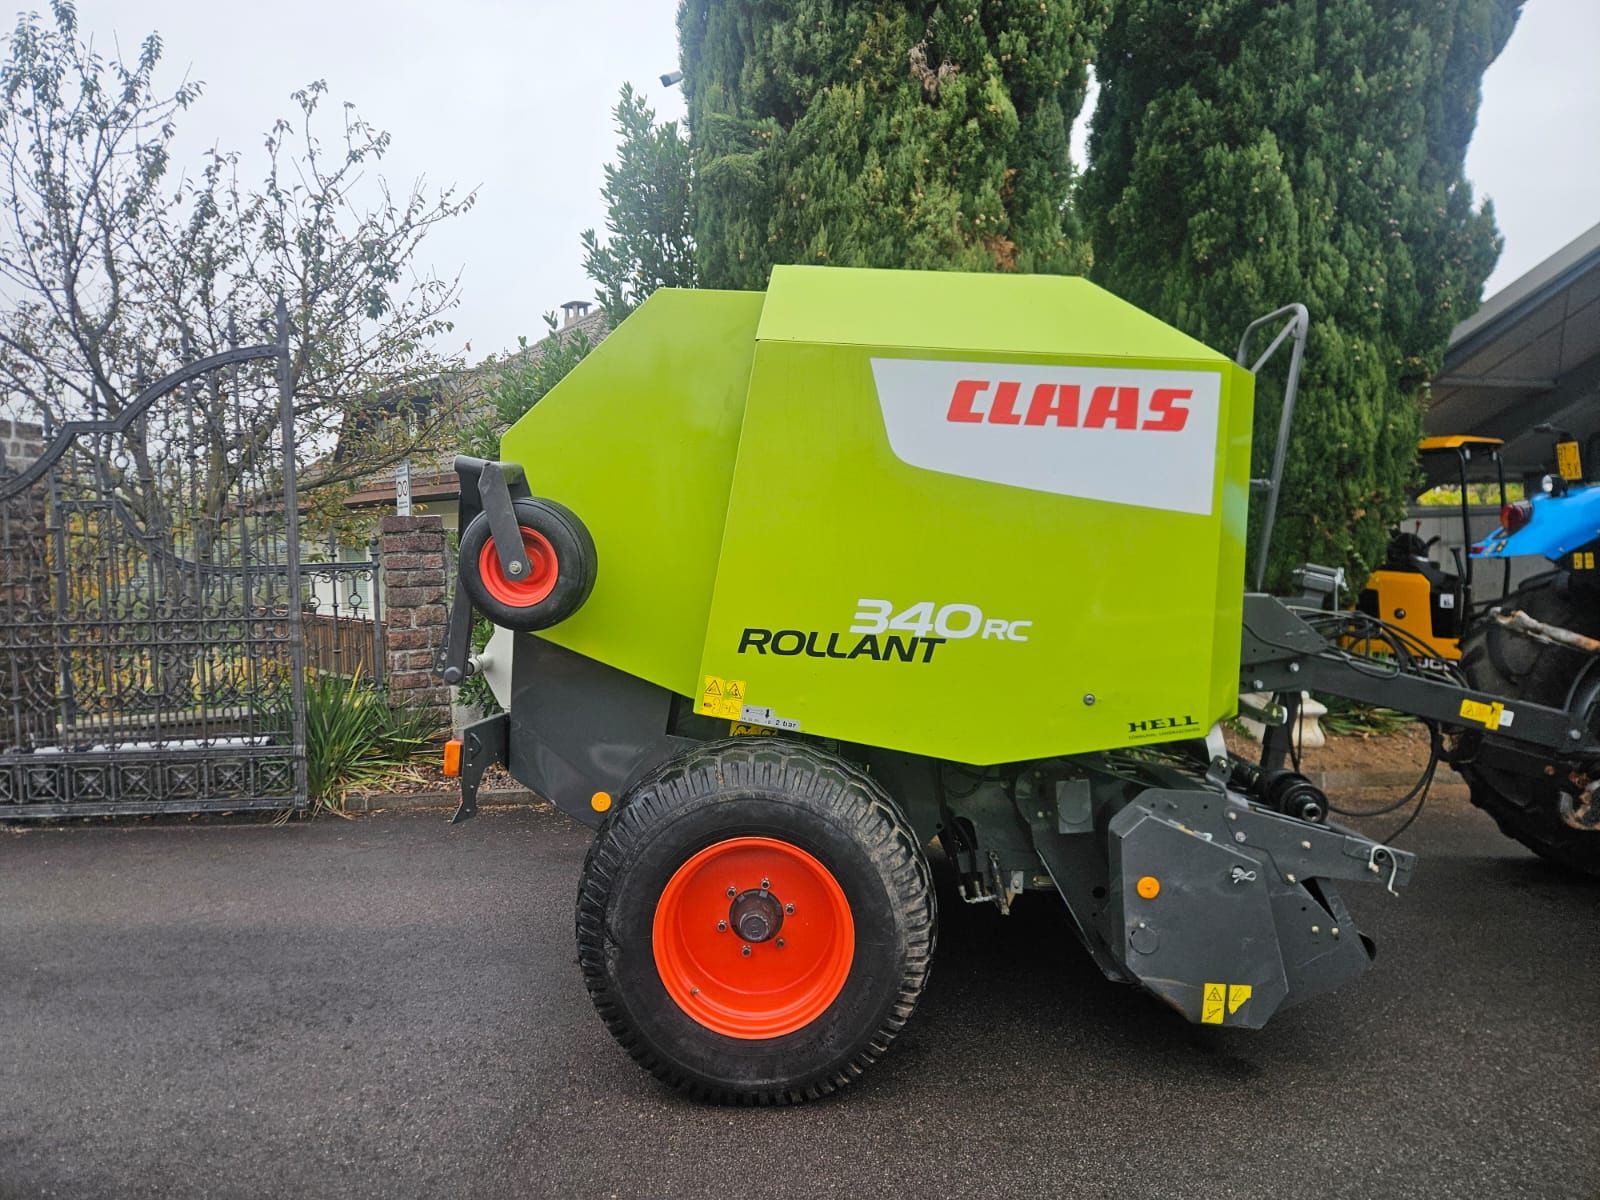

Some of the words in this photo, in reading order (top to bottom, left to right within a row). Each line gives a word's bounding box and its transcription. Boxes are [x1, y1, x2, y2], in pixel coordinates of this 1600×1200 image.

[946, 380, 1194, 432] CLAAS
[850, 598, 983, 639] 340
[982, 618, 1033, 642] RC
[737, 628, 947, 664] ROLLANT
[782, 720, 797, 728] bar
[1128, 714, 1200, 733] HELL
